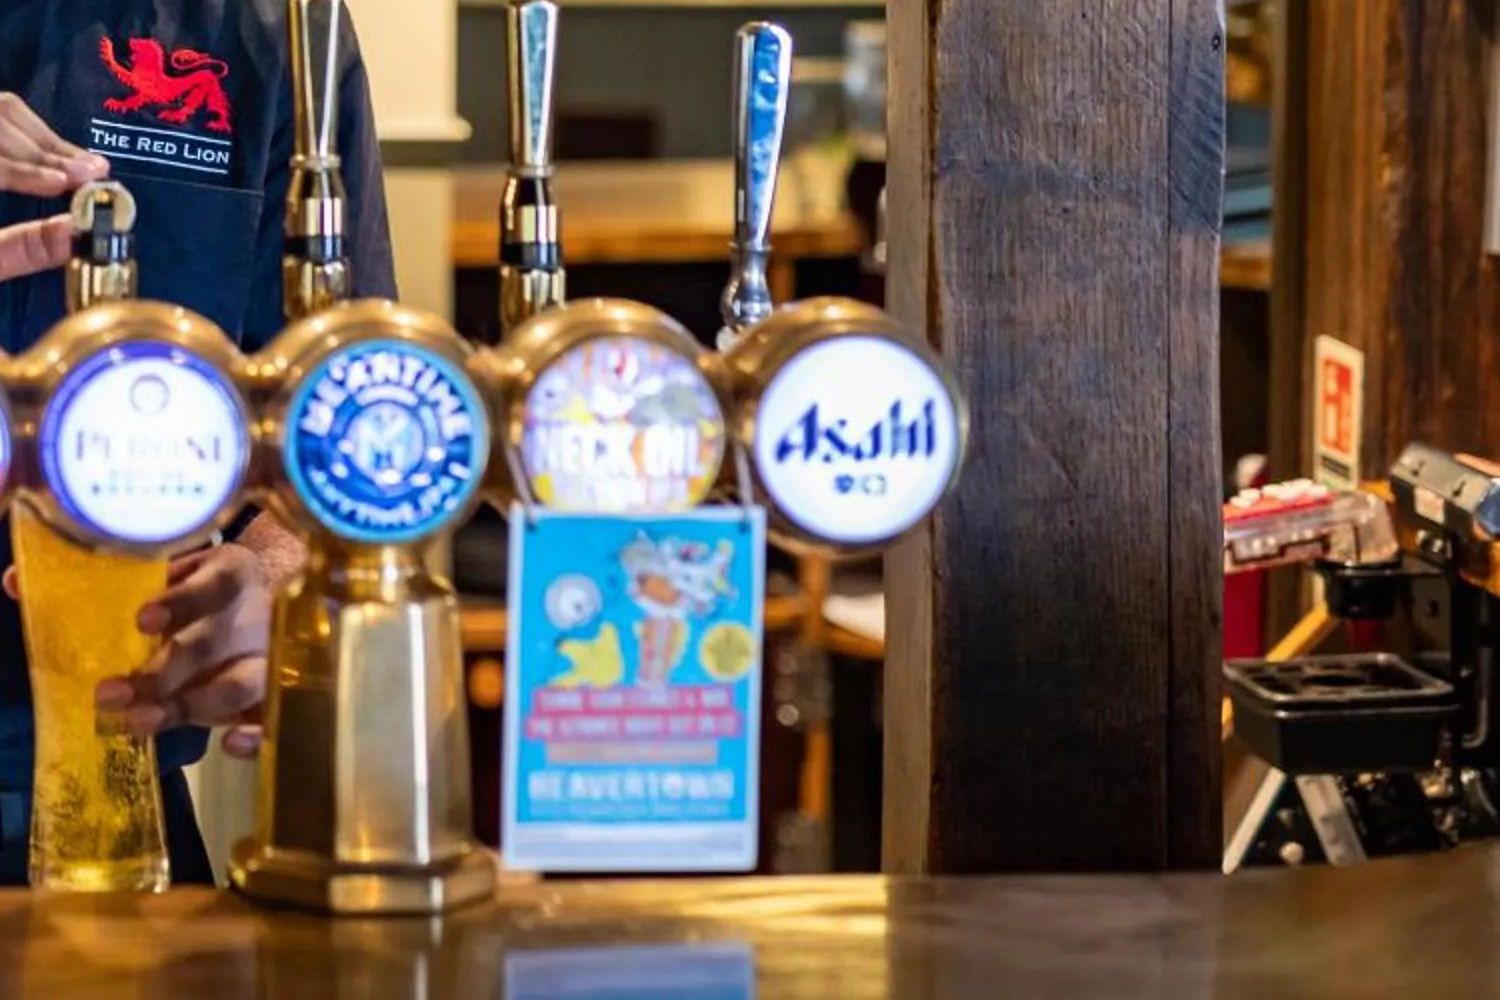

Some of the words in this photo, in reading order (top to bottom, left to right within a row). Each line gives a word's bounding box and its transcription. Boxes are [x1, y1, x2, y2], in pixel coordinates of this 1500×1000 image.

[90, 128, 131, 149] THE
[137, 136, 178, 156] RED
[183, 143, 231, 165] LION
[775, 398, 935, 465] Asahi
